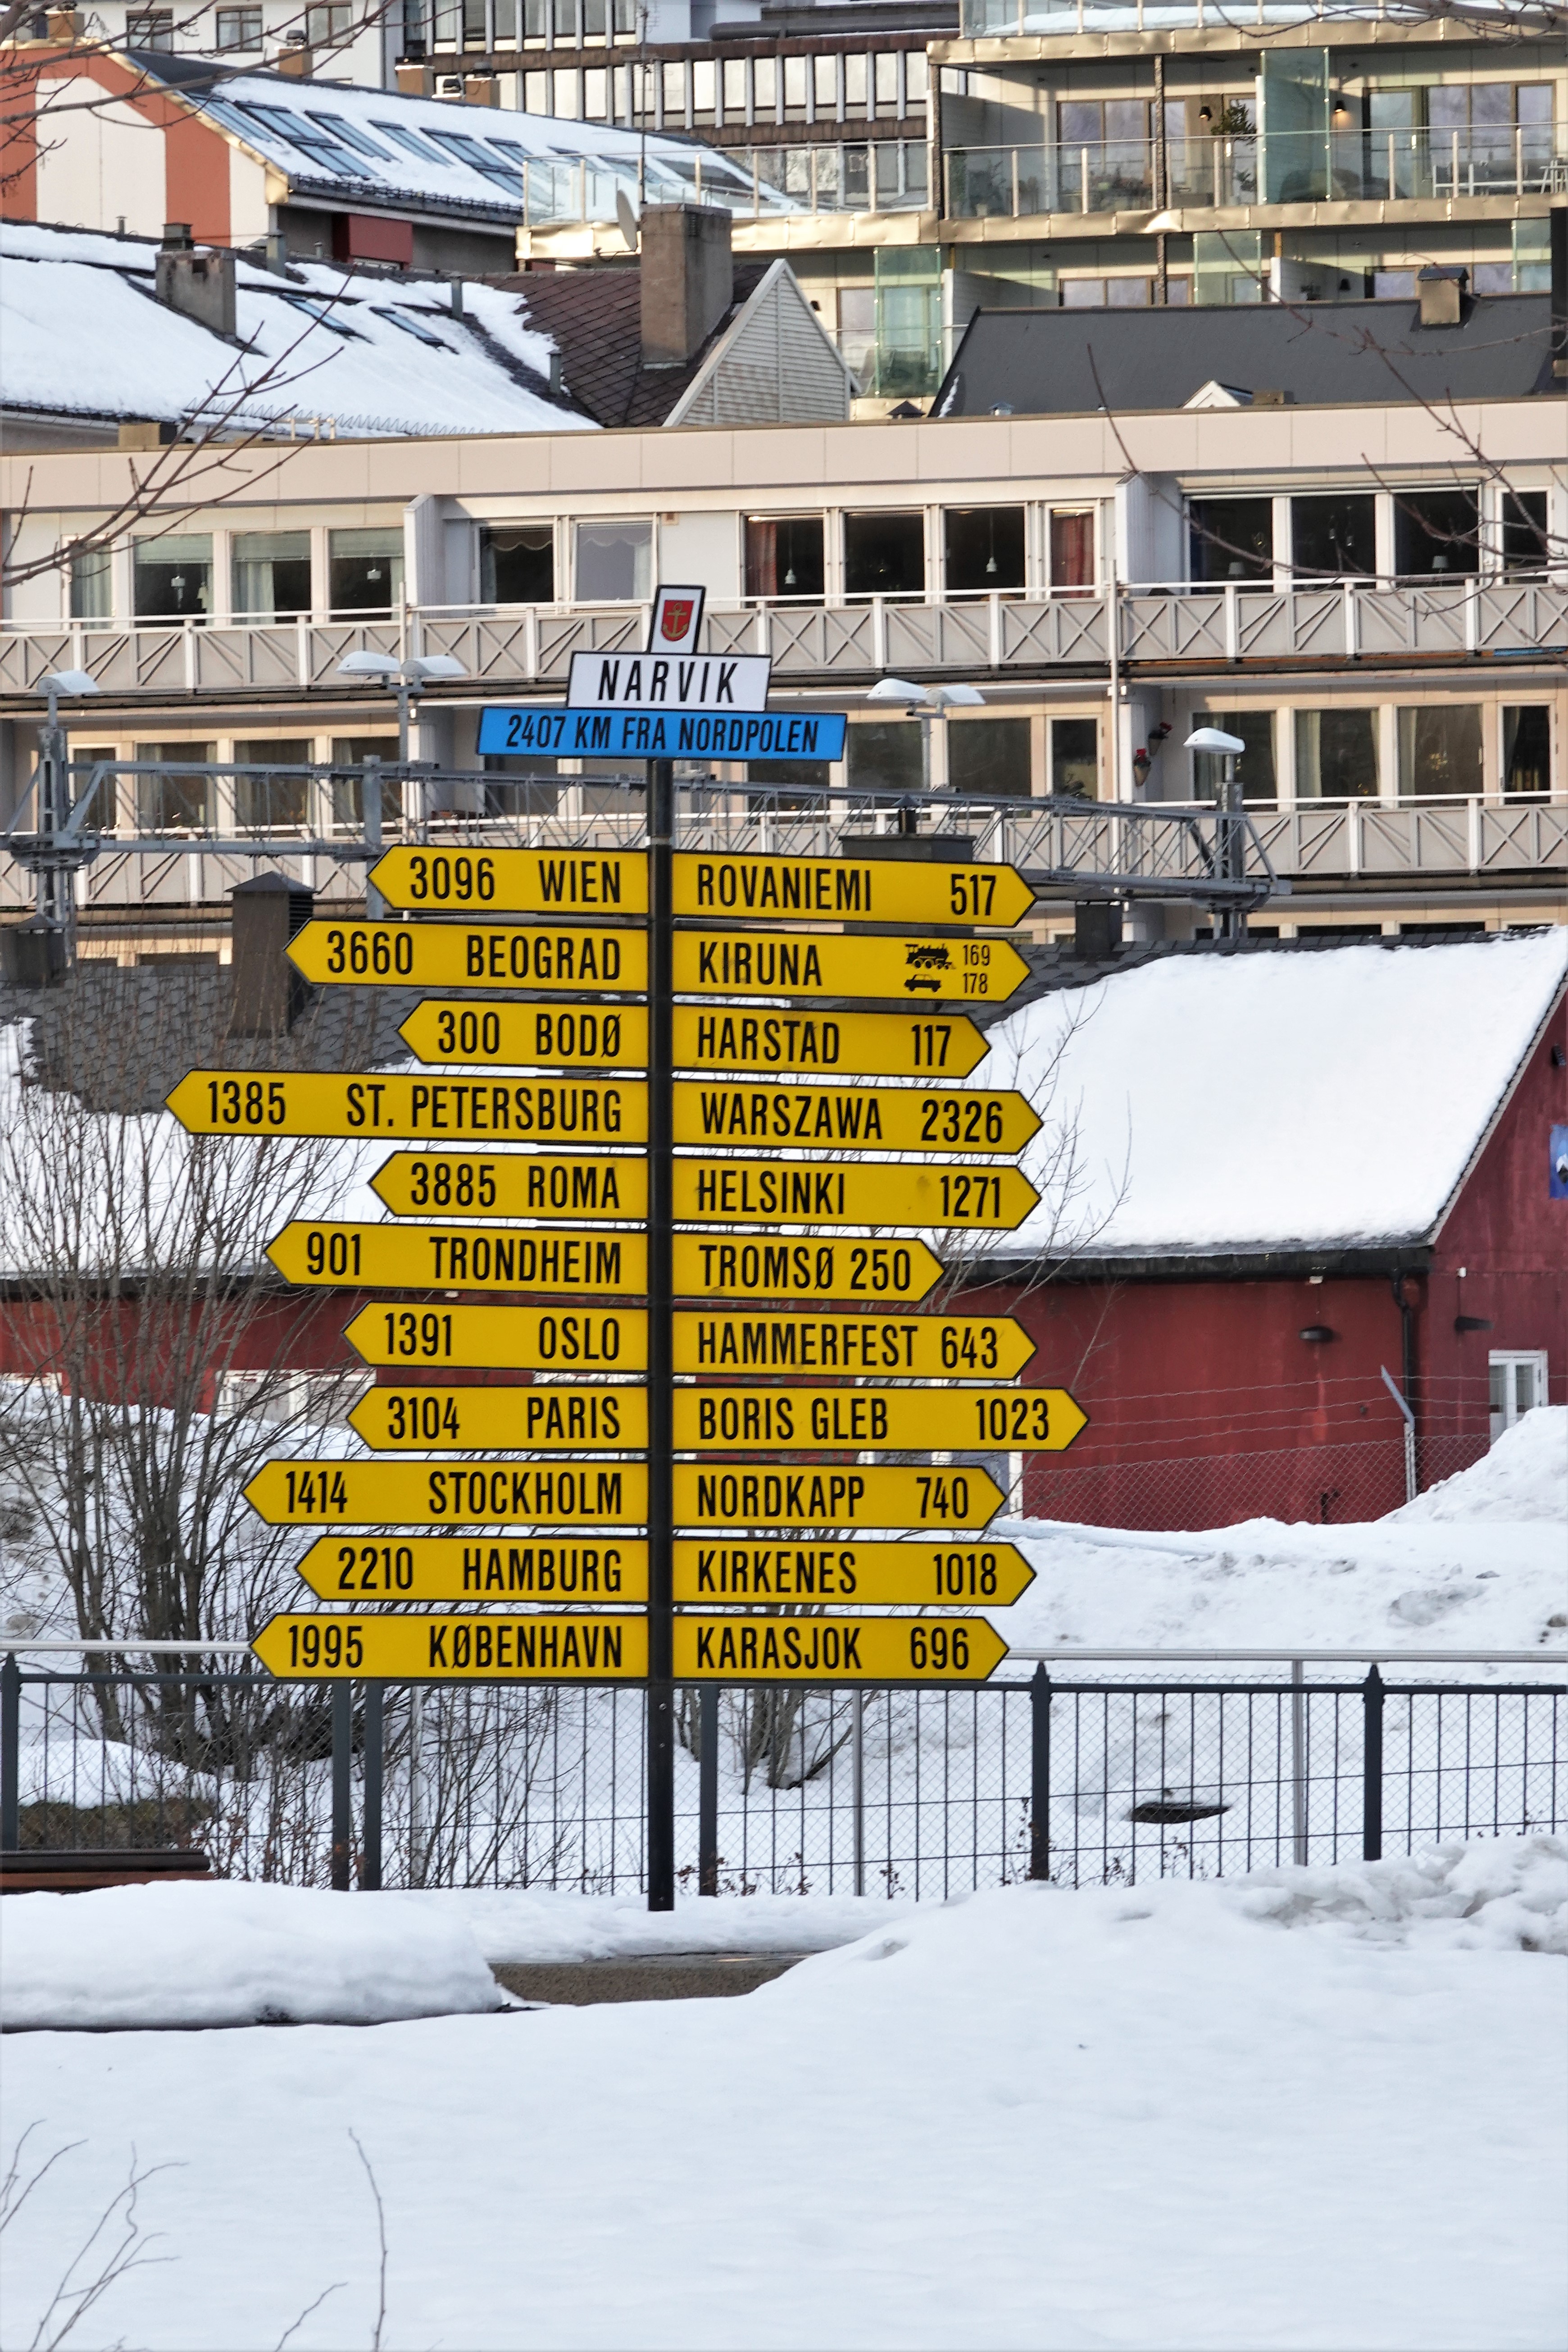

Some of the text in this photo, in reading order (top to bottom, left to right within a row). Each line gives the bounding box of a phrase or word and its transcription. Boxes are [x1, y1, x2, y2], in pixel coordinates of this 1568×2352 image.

[598, 660, 738, 703] NARVIK
[506, 714, 818, 752] 2407 KM FRA NORDPOLEN
[410, 856, 620, 903] 3096 WIEN
[698, 864, 996, 916] ROVANIEMI 517
[328, 930, 620, 980] 3660 BEOGRAD
[700, 942, 822, 986] KIRUNA
[964, 945, 990, 966] 169
[963, 973, 987, 994] 178
[439, 1010, 621, 1057] 300 BODØ
[698, 1016, 951, 1066] HARSTAD 117
[209, 1081, 620, 1132] 1385 ST. PETERSBURG
[701, 1092, 1002, 1143] WARSZAWA 2326
[411, 1162, 619, 1208] 3885 ROMA
[697, 1170, 1000, 1218] HELSINKI 1271
[308, 1232, 620, 1283] 901 TRONDHEIM
[699, 1245, 910, 1291] TROMSØ 250
[385, 1313, 619, 1360] 1391 OSLO
[699, 1322, 997, 1369] HAMMERFEST 643
[388, 1397, 620, 1439] 3104 PARIS
[700, 1398, 1049, 1440] BORIS GLEB 1023
[286, 1471, 621, 1515] 1414 STOCKHOLM
[699, 1475, 968, 1519] NORDKAPP 740
[339, 1547, 620, 1592] 2210 HAMBURG
[699, 1551, 996, 1595] KIRKENES 1018
[289, 1624, 621, 1668] 1995 KØBENHAVN
[698, 1627, 968, 1670] KARASJOK 696
